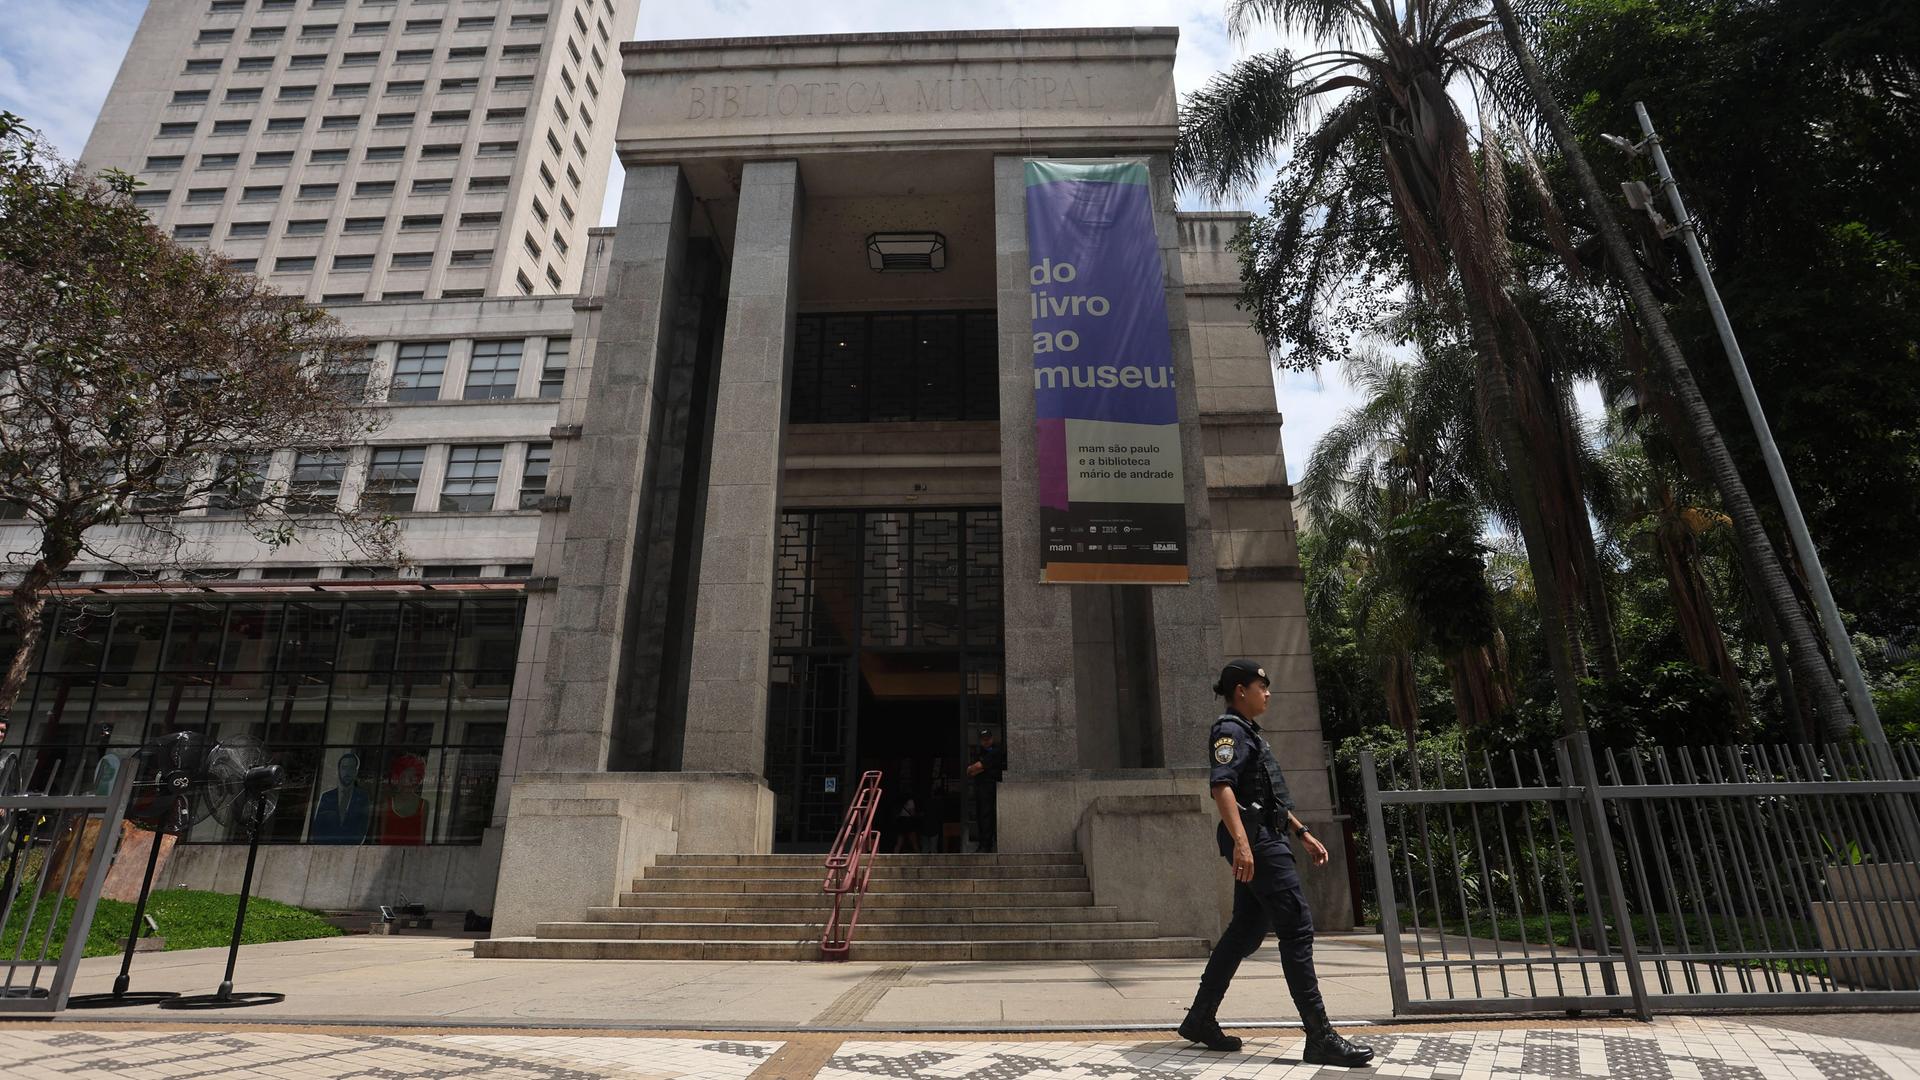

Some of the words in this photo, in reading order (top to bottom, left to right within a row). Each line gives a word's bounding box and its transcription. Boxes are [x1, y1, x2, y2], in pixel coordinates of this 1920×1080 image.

[685, 81, 890, 119] BIBLIOTECA
[914, 76, 1105, 112] MUNICIPAL
[1030, 258, 1076, 286] do
[1031, 291, 1110, 320] livro
[1033, 329, 1080, 353] ao
[1034, 365, 1176, 390] museu:
[1078, 445, 1105, 453] mam
[1108, 444, 1128, 454] são
[1130, 444, 1160, 455] paulo
[1079, 458, 1086, 466] e
[1088, 458, 1095, 466] a
[1098, 456, 1151, 466] biblioteca
[1080, 469, 1111, 479] mário
[1114, 470, 1127, 479] de
[1130, 470, 1174, 479] andrade
